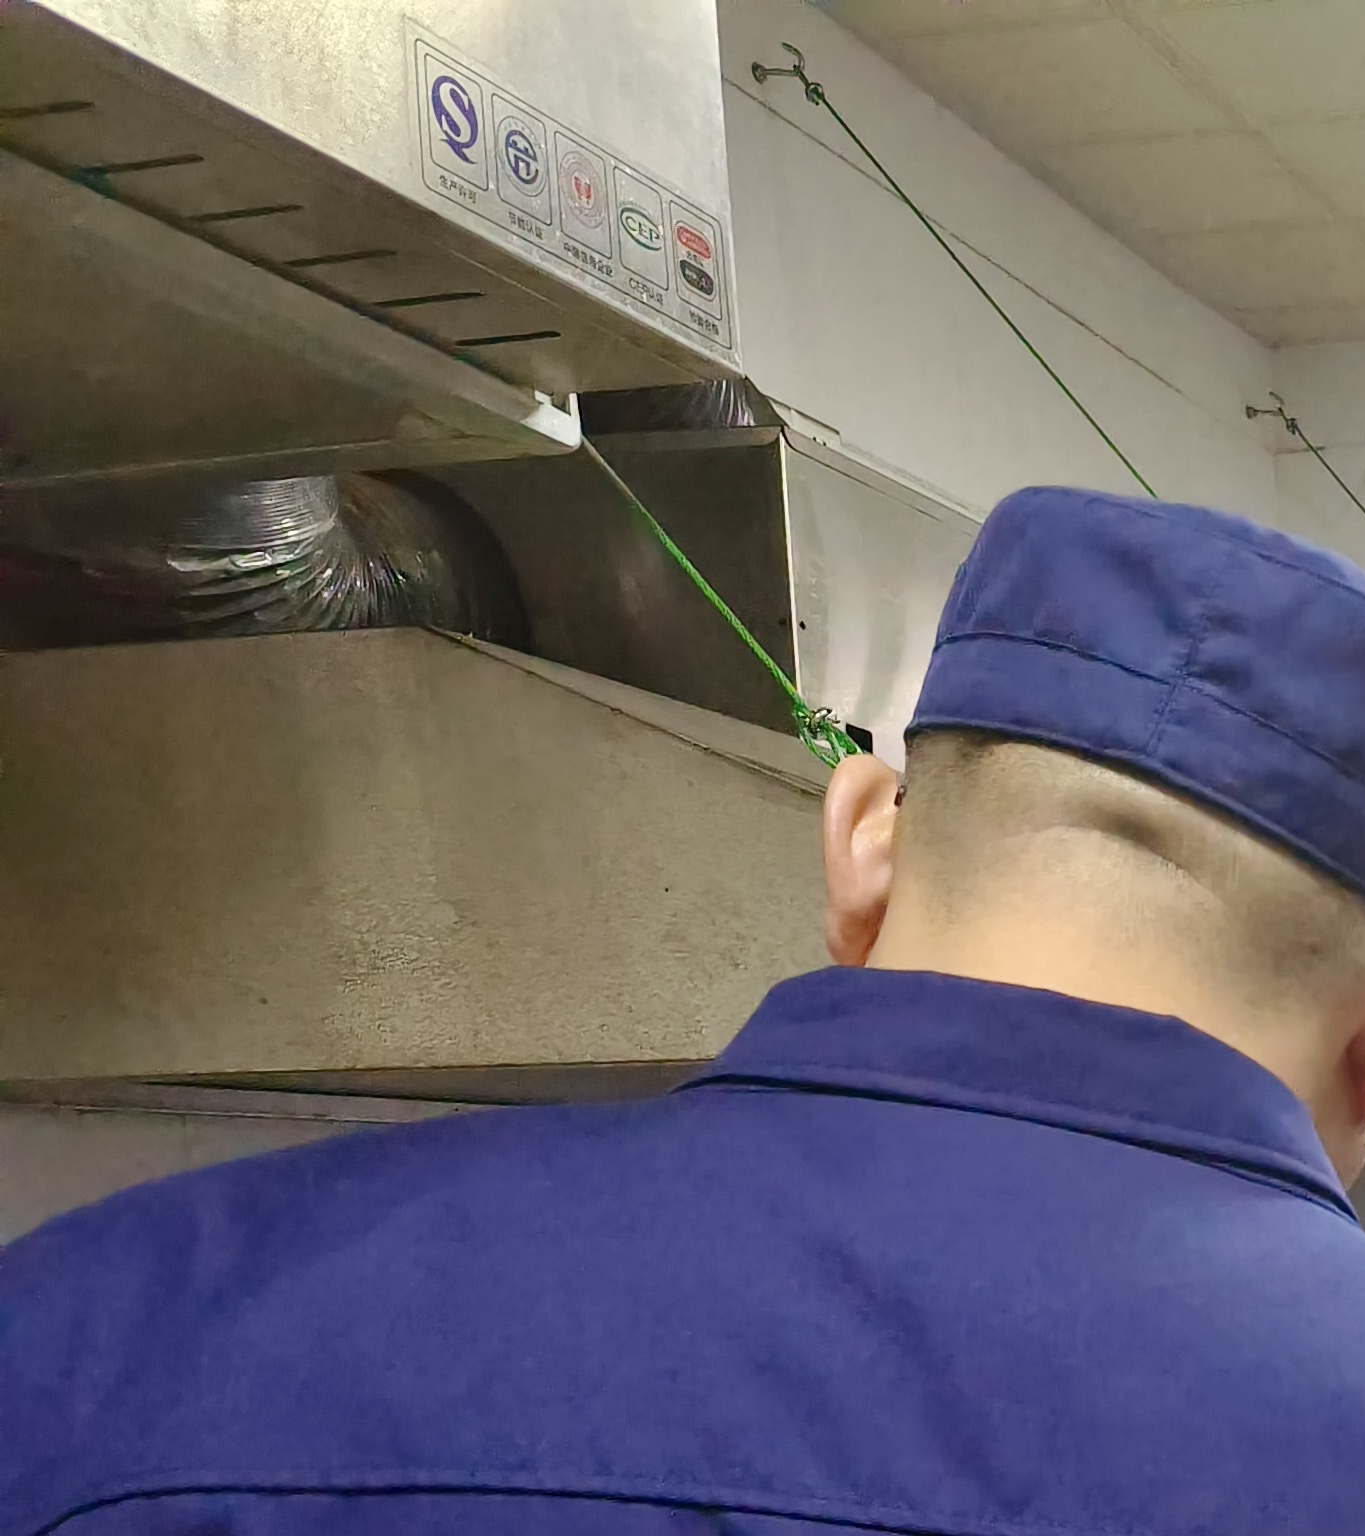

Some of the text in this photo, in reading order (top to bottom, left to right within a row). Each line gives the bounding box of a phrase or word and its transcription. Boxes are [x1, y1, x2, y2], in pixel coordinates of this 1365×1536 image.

[439, 174, 477, 204] 生产许可
[508, 211, 543, 240] 节能认证
